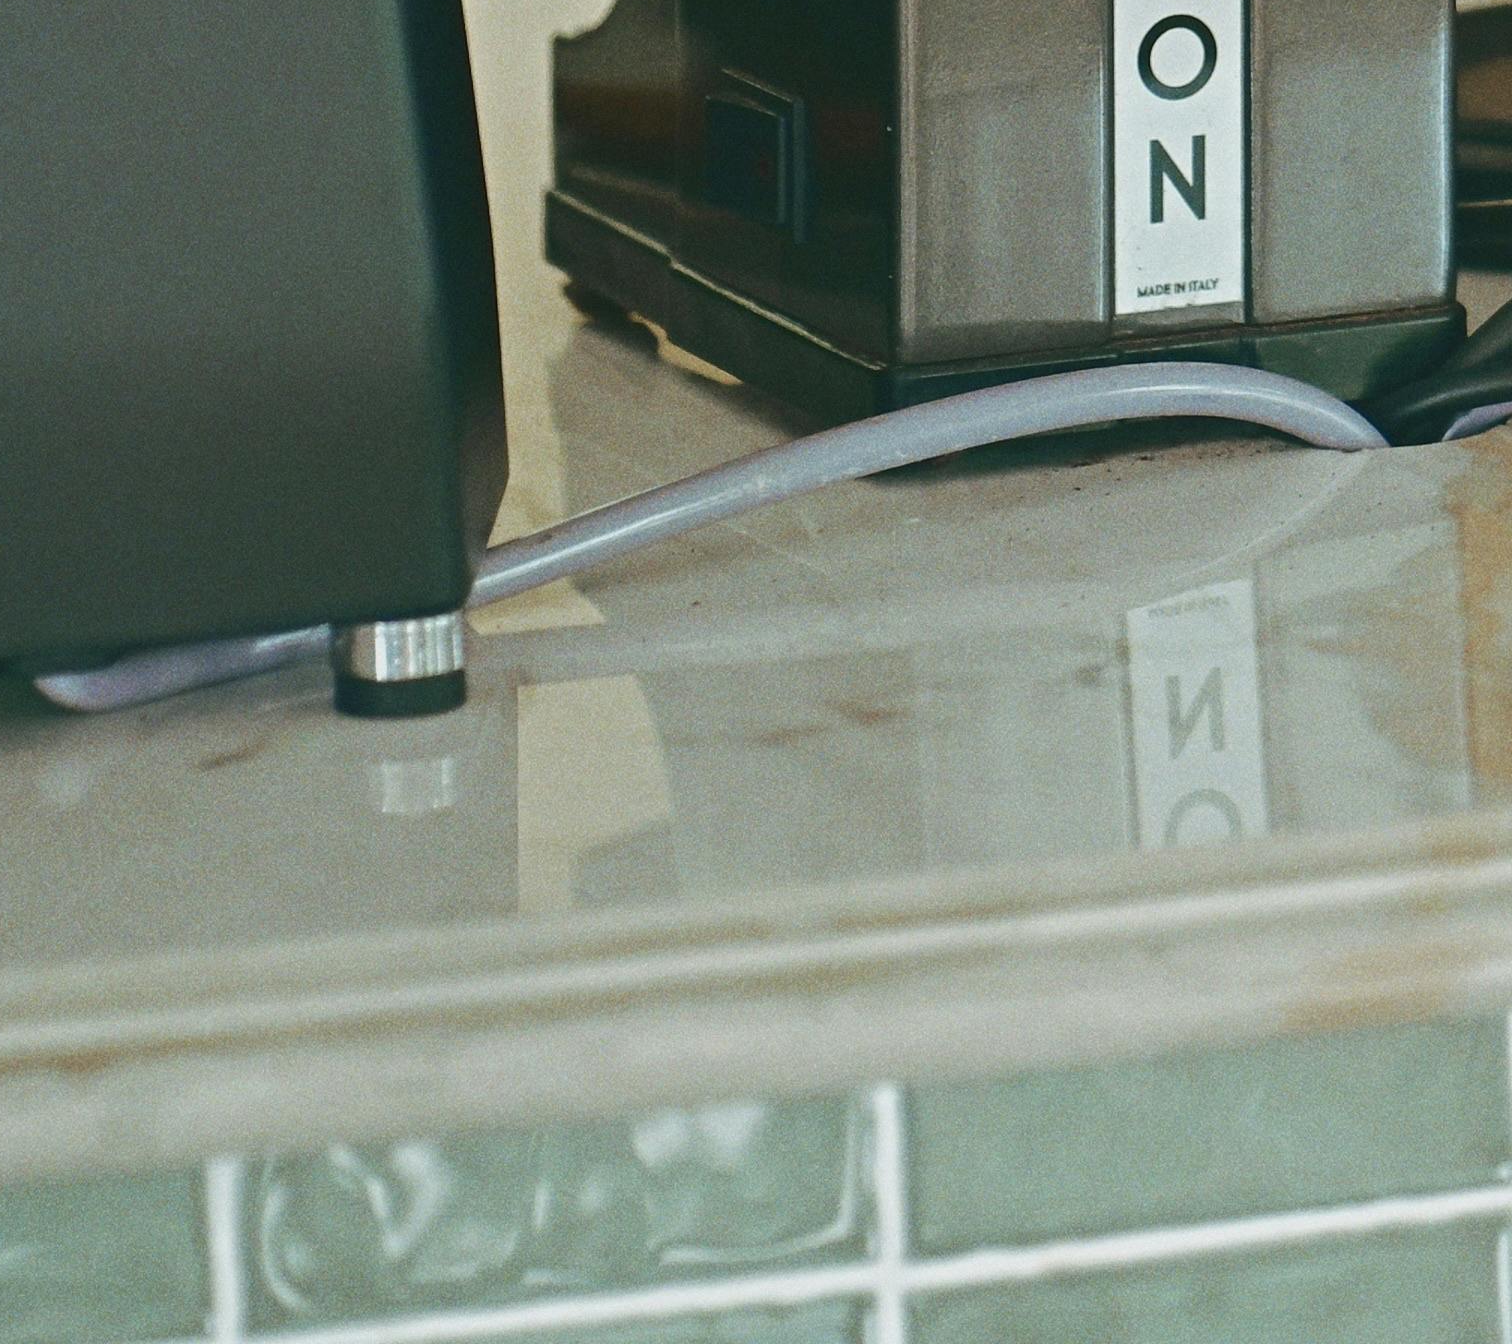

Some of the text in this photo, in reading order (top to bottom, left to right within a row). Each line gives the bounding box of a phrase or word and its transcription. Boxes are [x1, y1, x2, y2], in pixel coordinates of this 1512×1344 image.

[1137, 278, 1219, 298] MADE IN ITALY
